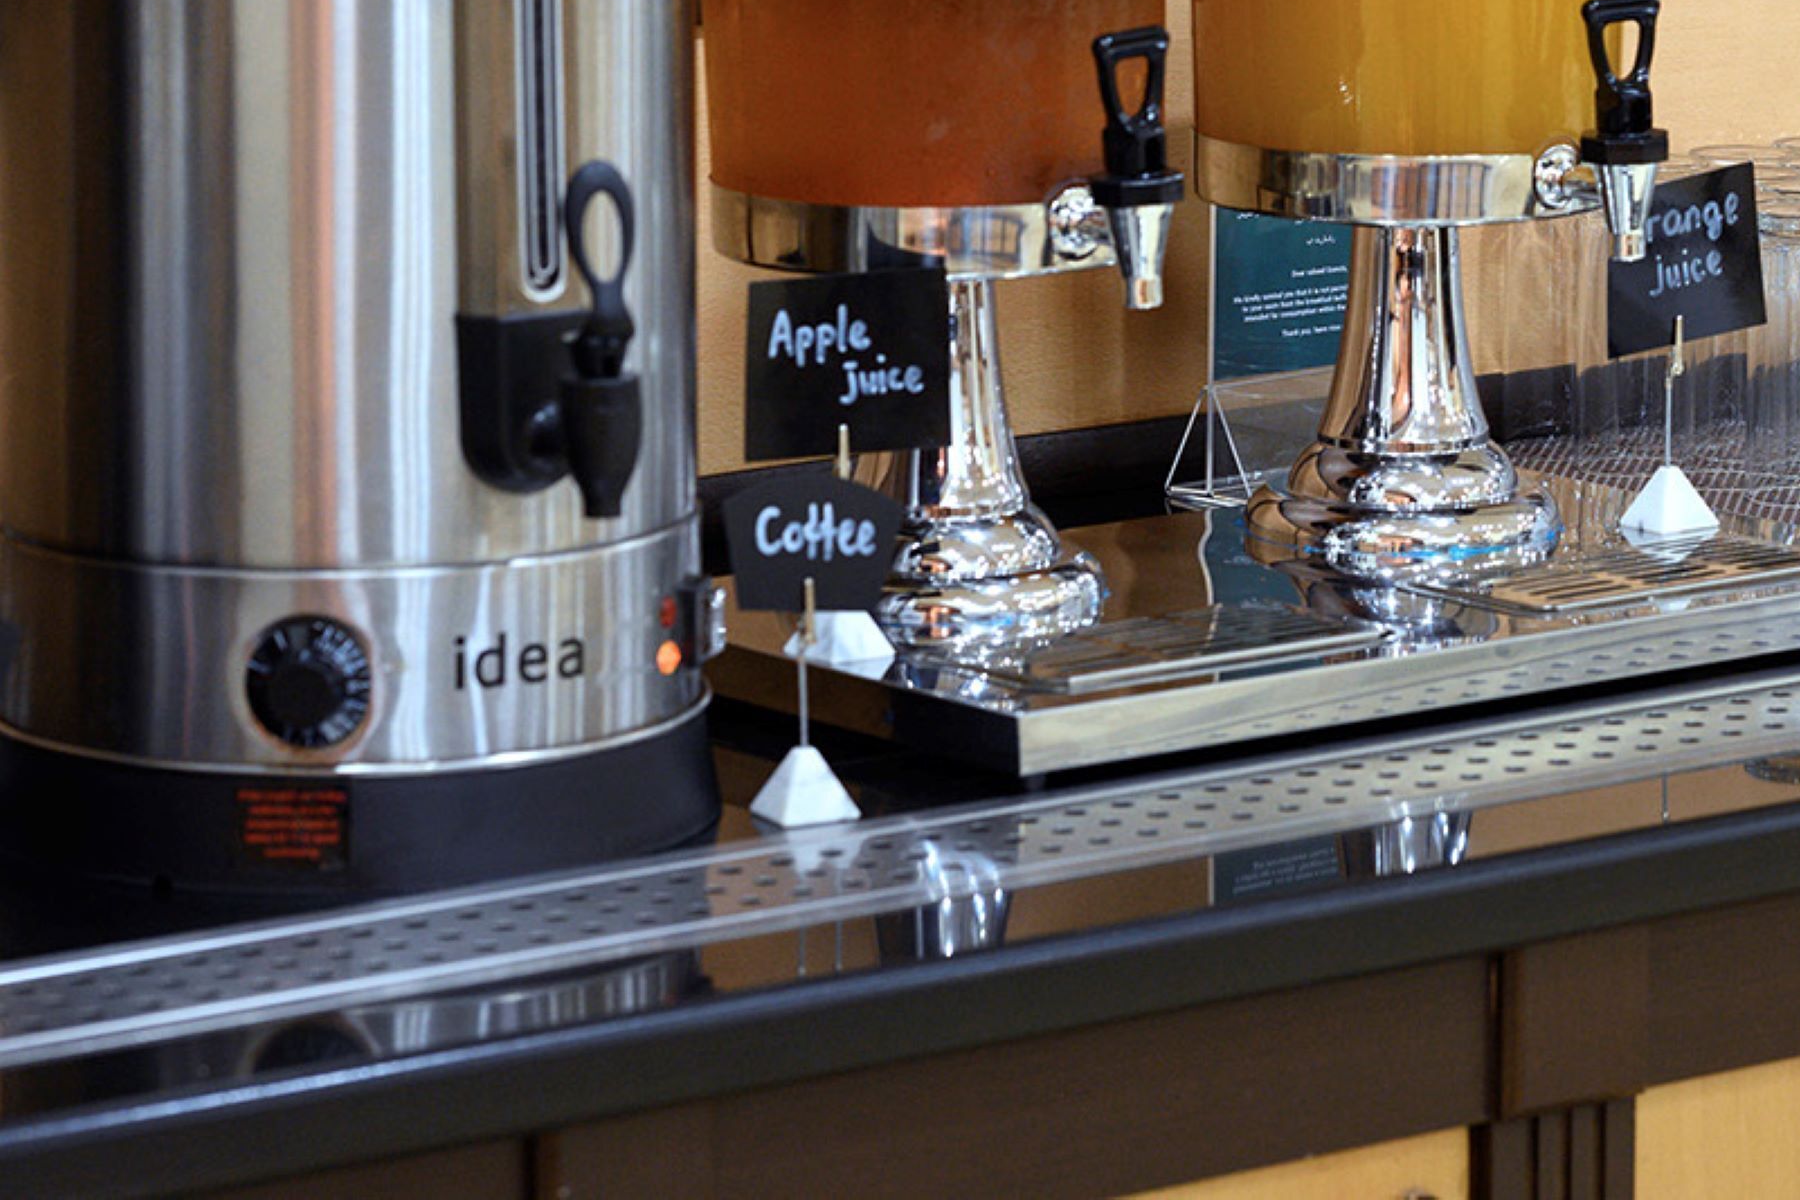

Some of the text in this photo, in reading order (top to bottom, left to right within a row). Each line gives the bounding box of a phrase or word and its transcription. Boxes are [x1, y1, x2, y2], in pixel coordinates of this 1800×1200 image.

[1646, 191, 1740, 243] range
[1649, 247, 1724, 298] juice
[768, 302, 871, 367] Apple
[754, 501, 877, 562] Coffee
[454, 631, 585, 690] idea
